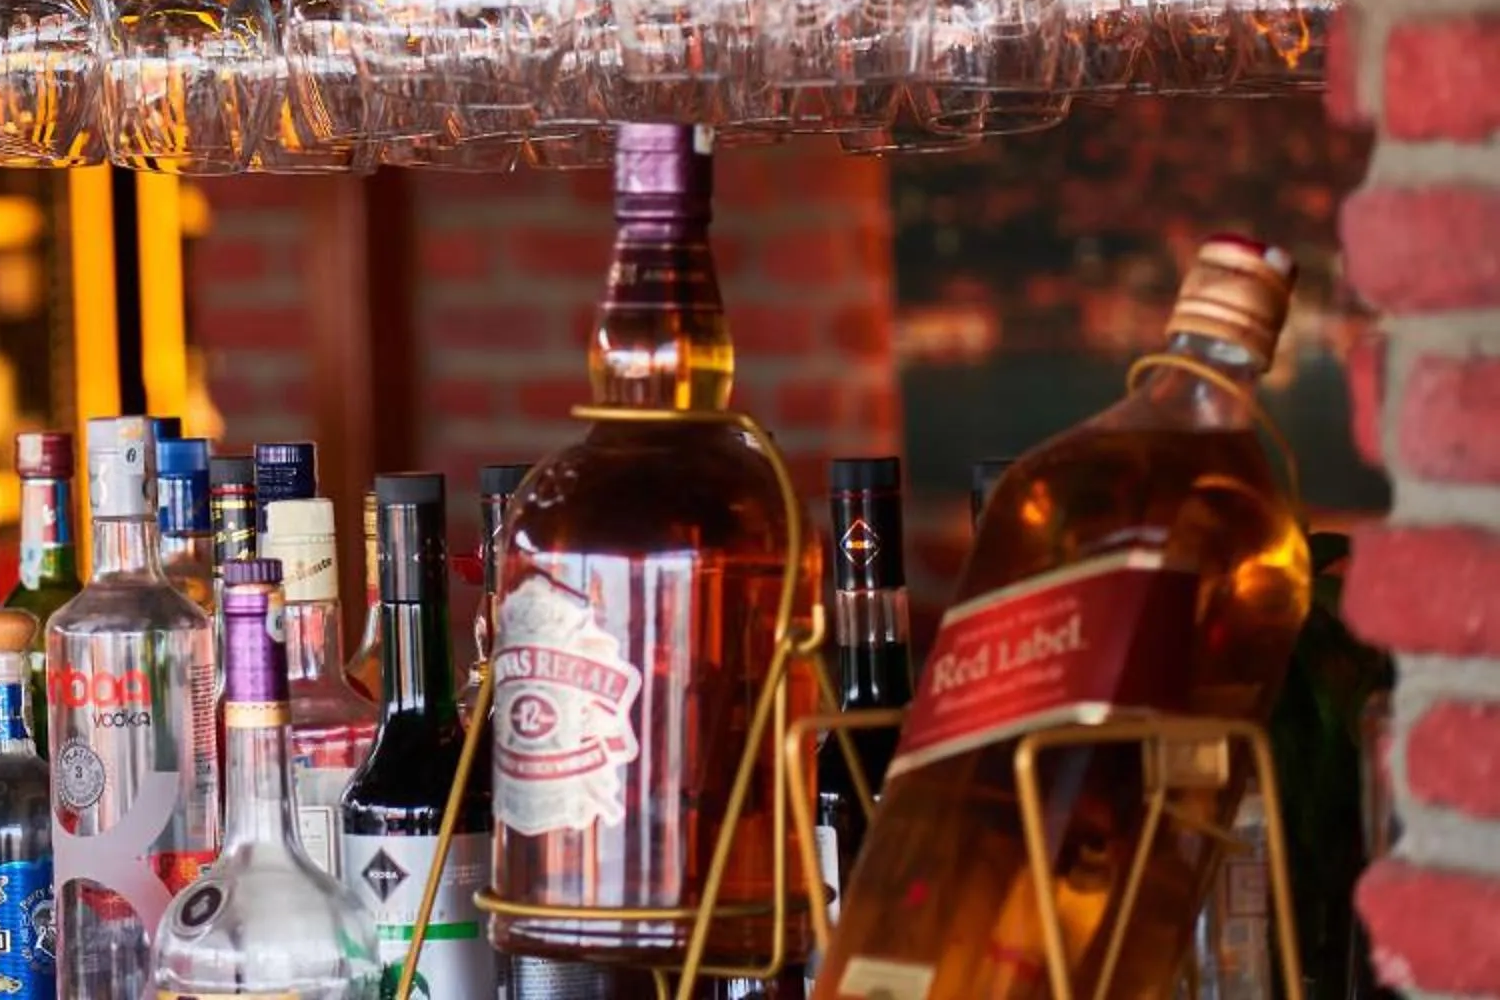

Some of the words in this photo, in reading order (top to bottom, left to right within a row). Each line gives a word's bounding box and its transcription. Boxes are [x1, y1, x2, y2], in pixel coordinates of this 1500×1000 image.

[536, 650, 622, 700] REGAL
[931, 642, 990, 695] Red
[997, 614, 1084, 672] Label
[93, 709, 151, 729] vodka
